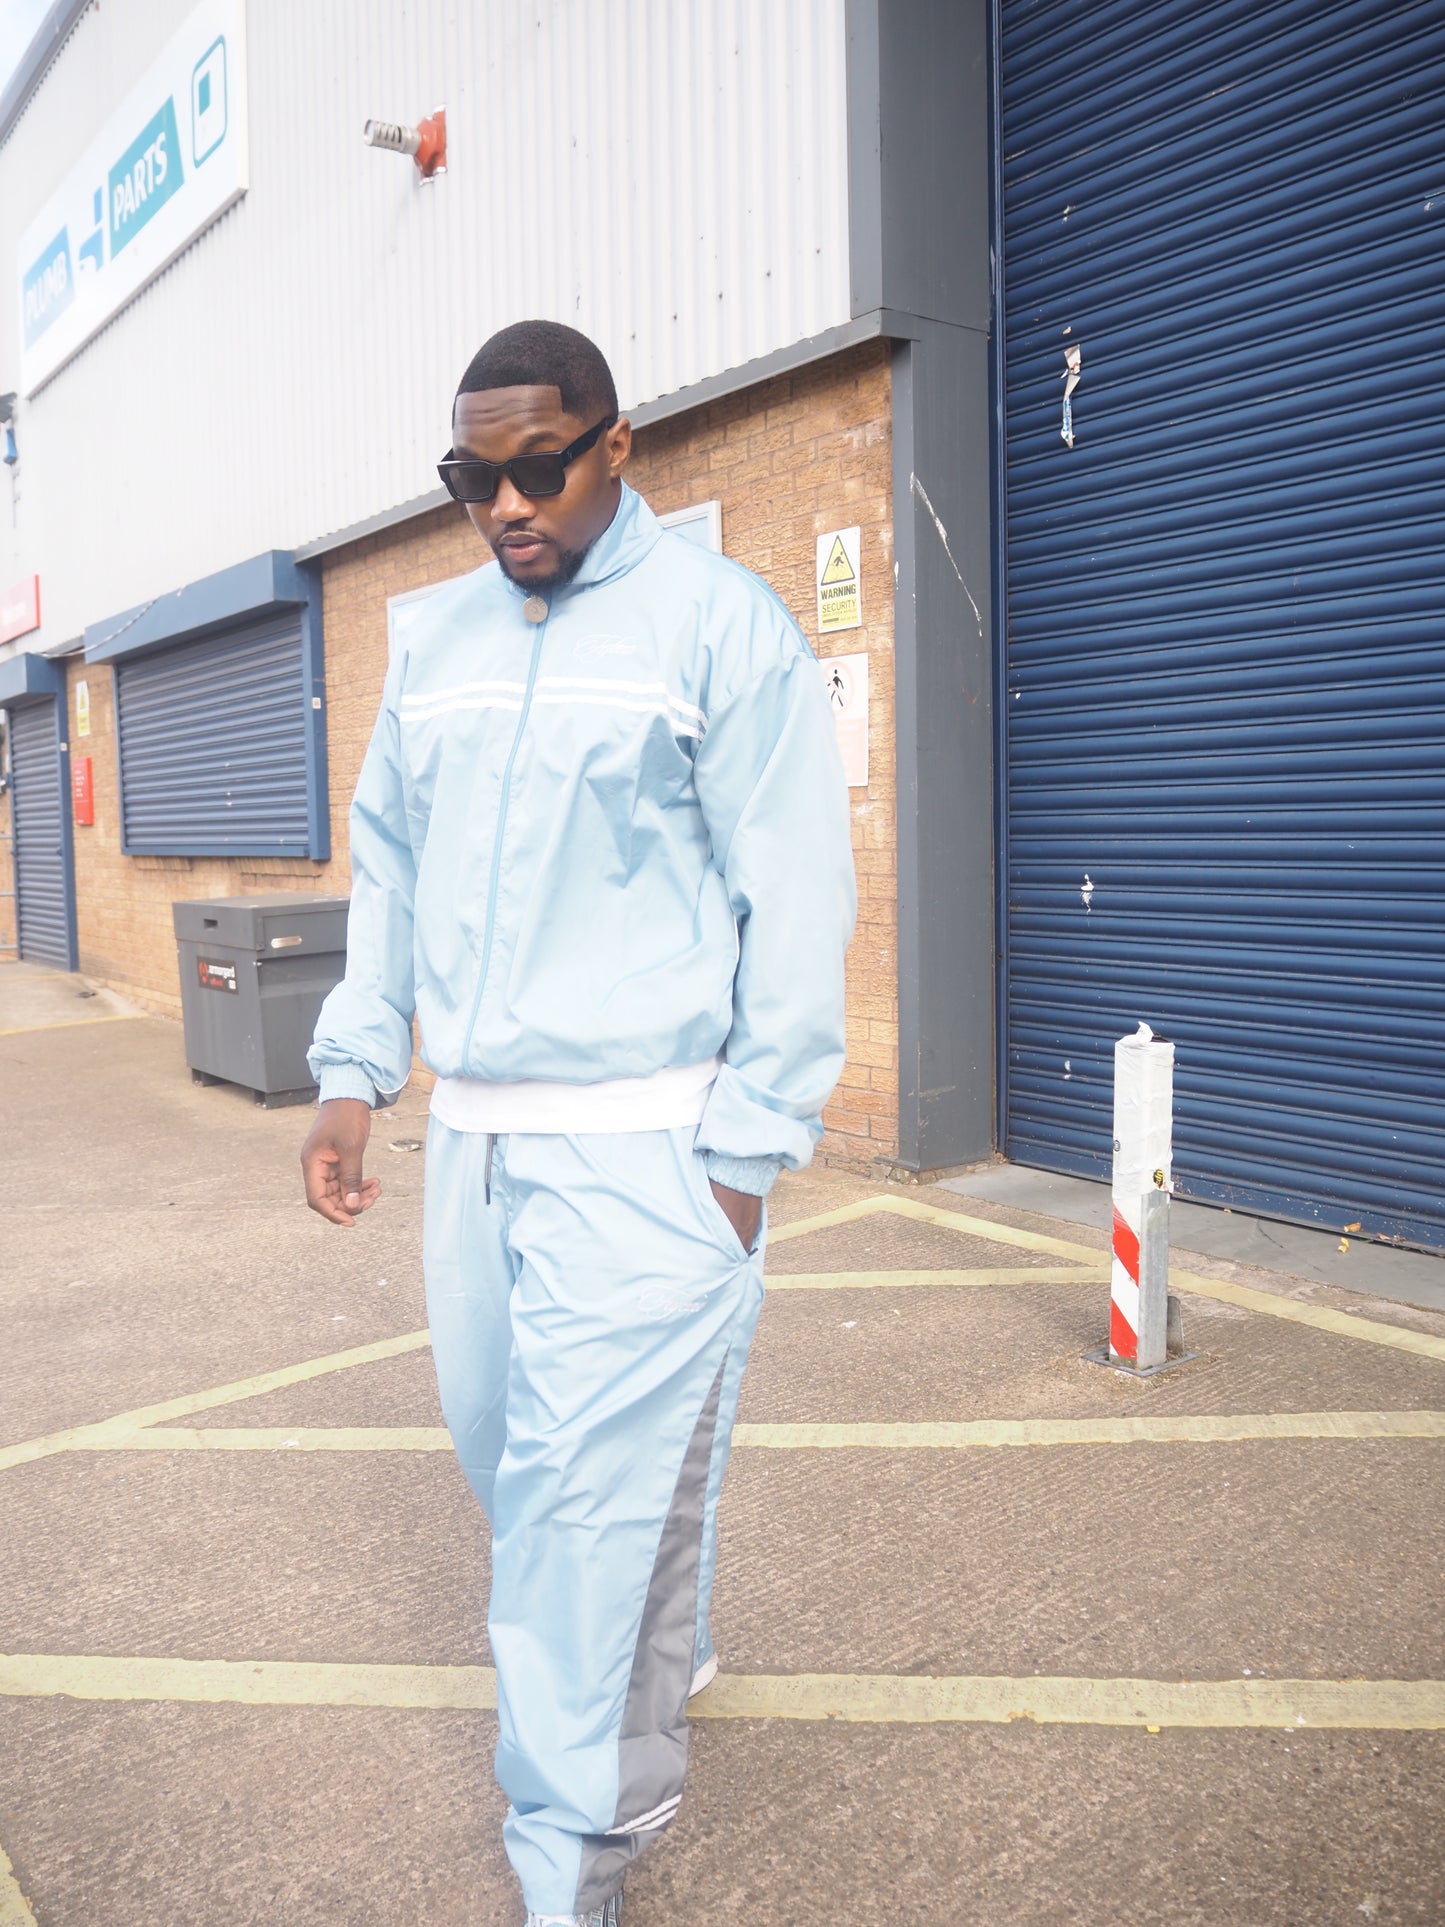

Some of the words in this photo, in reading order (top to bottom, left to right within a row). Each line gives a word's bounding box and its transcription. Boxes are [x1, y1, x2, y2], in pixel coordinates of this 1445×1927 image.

[25, 250, 67, 327] PLUMB
[113, 132, 168, 231] PARTS
[821, 584, 856, 600] WARNING
[822, 599, 856, 613] SECURITY
